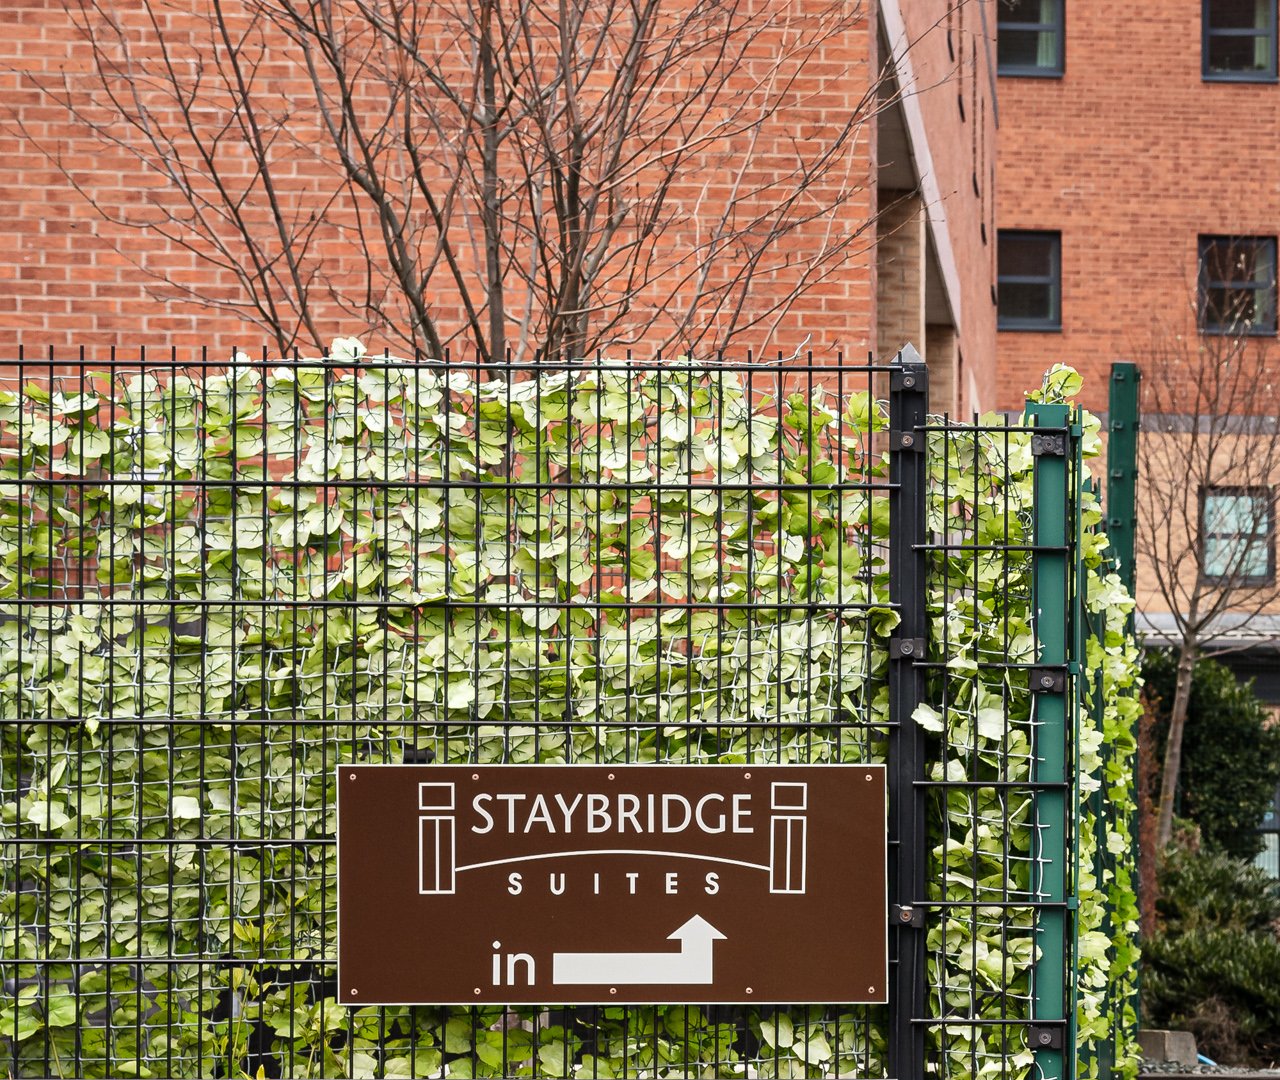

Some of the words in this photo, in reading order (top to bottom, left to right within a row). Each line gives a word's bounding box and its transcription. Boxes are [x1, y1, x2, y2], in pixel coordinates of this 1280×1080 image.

[471, 792, 754, 835] STAYBRIDGE
[507, 871, 720, 896] SUITES
[491, 940, 536, 986] in
